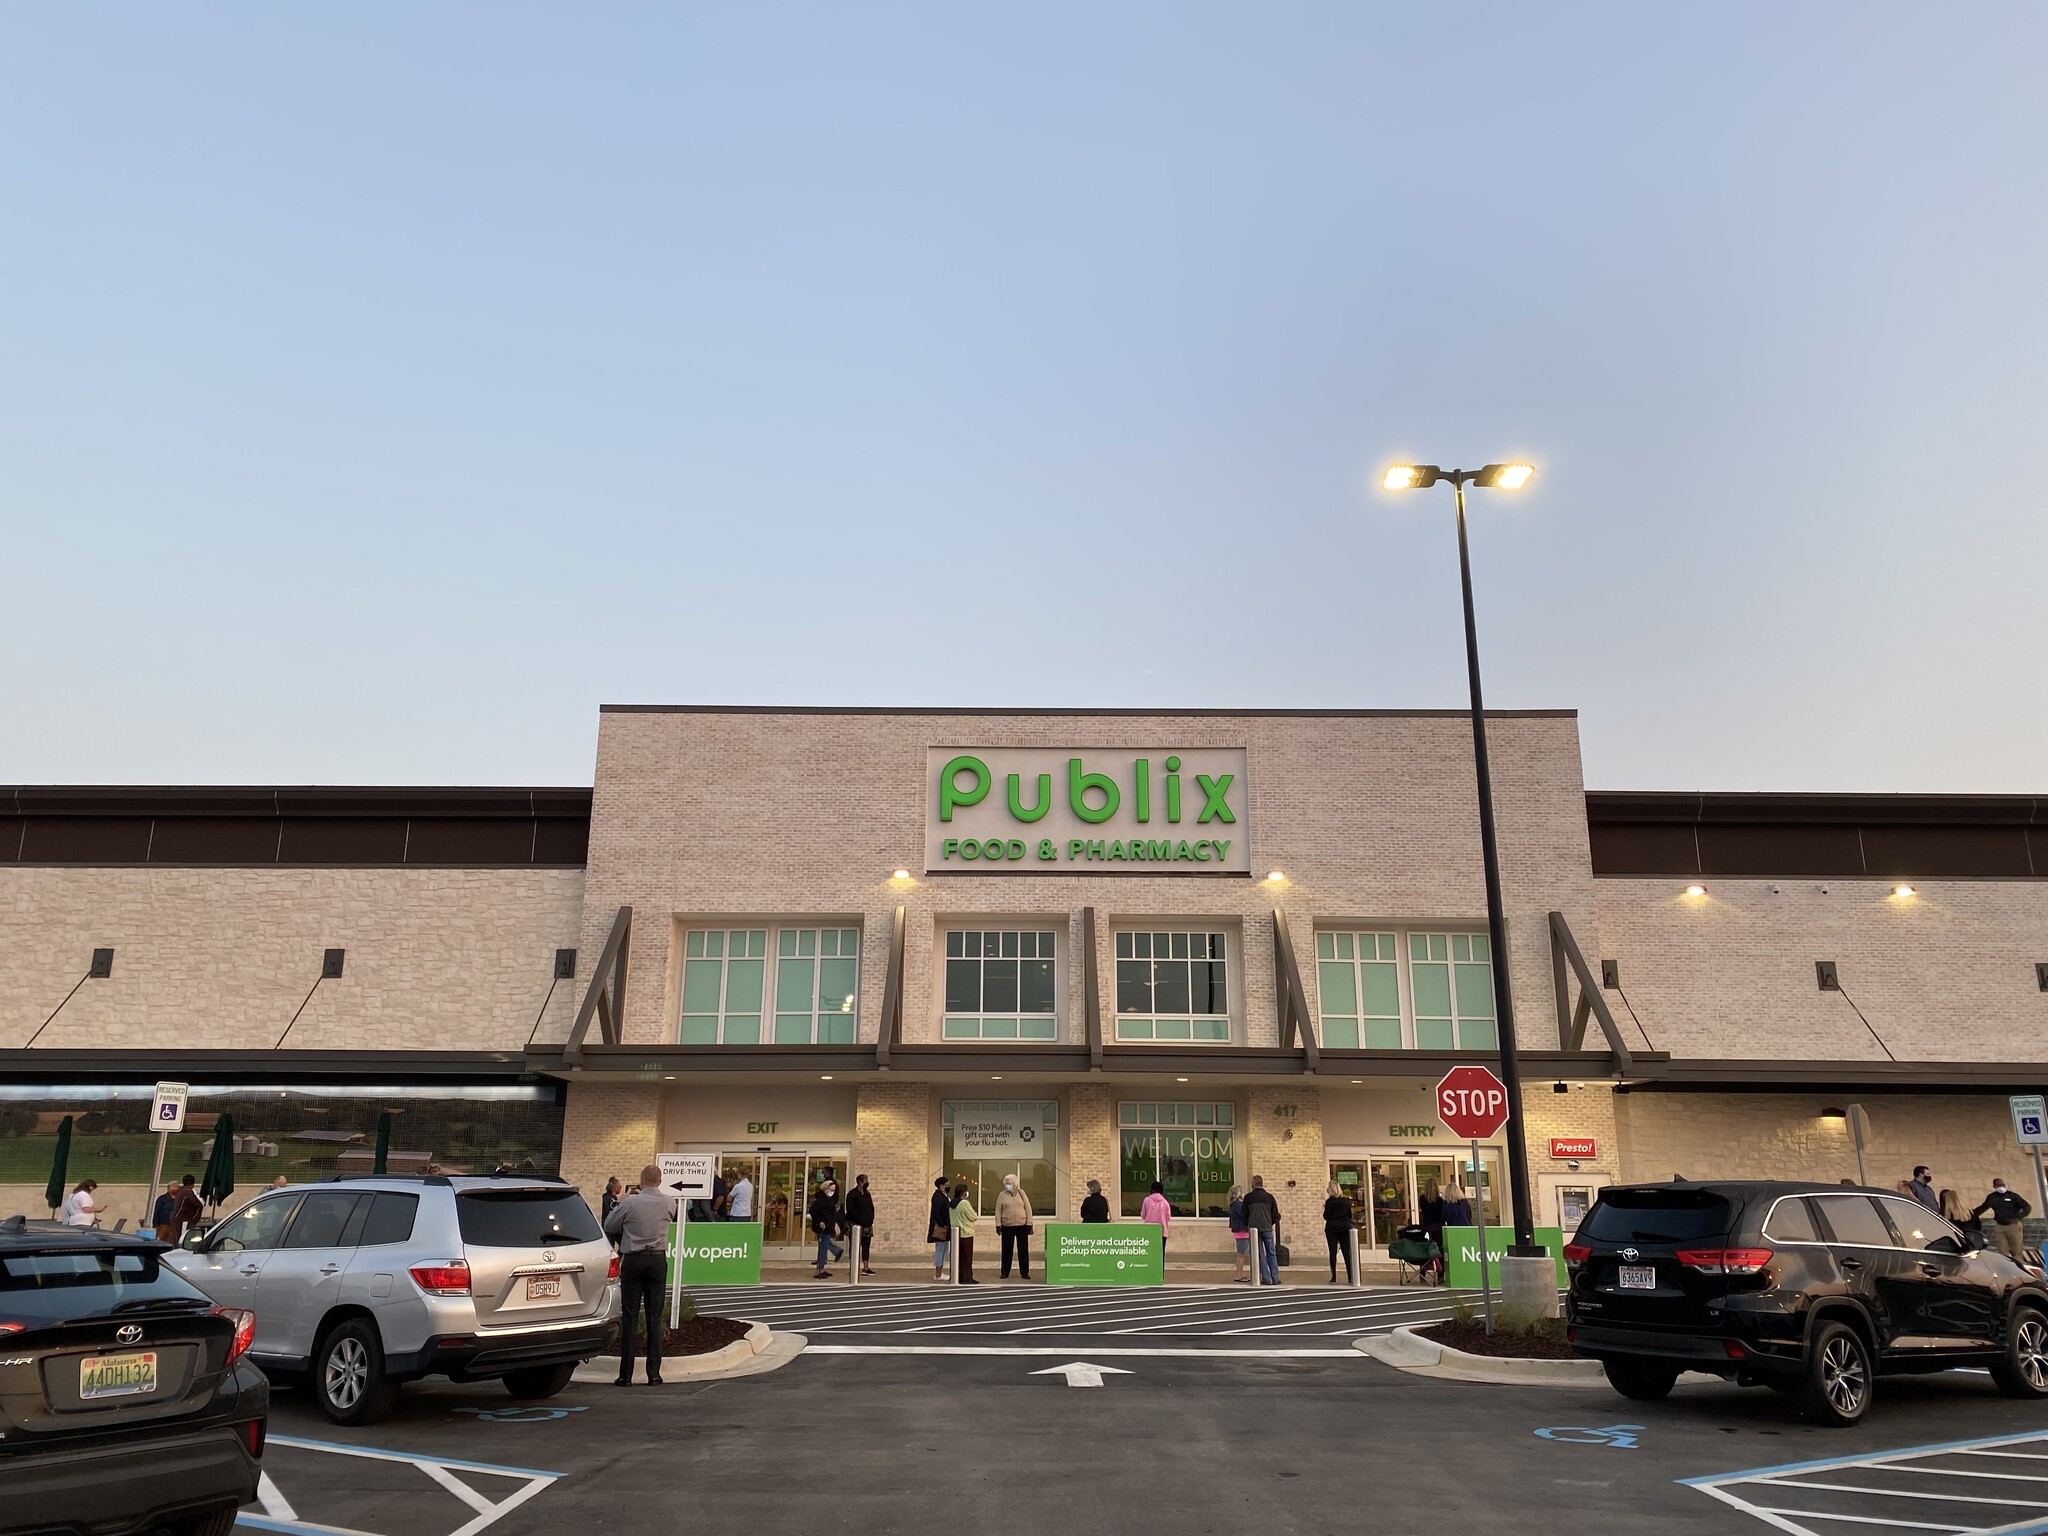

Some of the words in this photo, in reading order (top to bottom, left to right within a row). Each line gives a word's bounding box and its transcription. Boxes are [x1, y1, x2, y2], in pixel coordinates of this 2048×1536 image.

[939, 755, 1237, 824] Publix
[943, 838, 1027, 861] FOOD
[1038, 838, 1058, 861] &
[1068, 838, 1232, 862] PHARMACY
[160, 1094, 182, 1102] PARKING
[1442, 1089, 1502, 1117] STOP
[1273, 1104, 1298, 1118] 417
[747, 1122, 779, 1134] EXIT
[961, 1123, 977, 1131] Free
[978, 1123, 990, 1131] $10
[991, 1123, 1013, 1131] Publix
[1389, 1125, 1436, 1138] ENTRY
[964, 1131, 977, 1140] gift
[978, 1131, 994, 1139] card
[994, 1131, 1010, 1139] with
[964, 1139, 981, 1148] your
[981, 1139, 991, 1147] flu
[991, 1139, 1009, 1147] shot.
[1555, 1142, 1593, 1153] Presto!
[1131, 1170, 1148, 1181] TO
[1060, 1236, 1096, 1248] Delivery
[1096, 1237, 1113, 1246] and
[1113, 1237, 1150, 1246] curbside
[699, 1242, 748, 1264] open!
[1060, 1246, 1090, 1257] pickup
[1109, 1246, 1149, 1255] available.
[101, 1357, 137, 1367] Alabama
[86, 1363, 151, 1388] 44DH132
